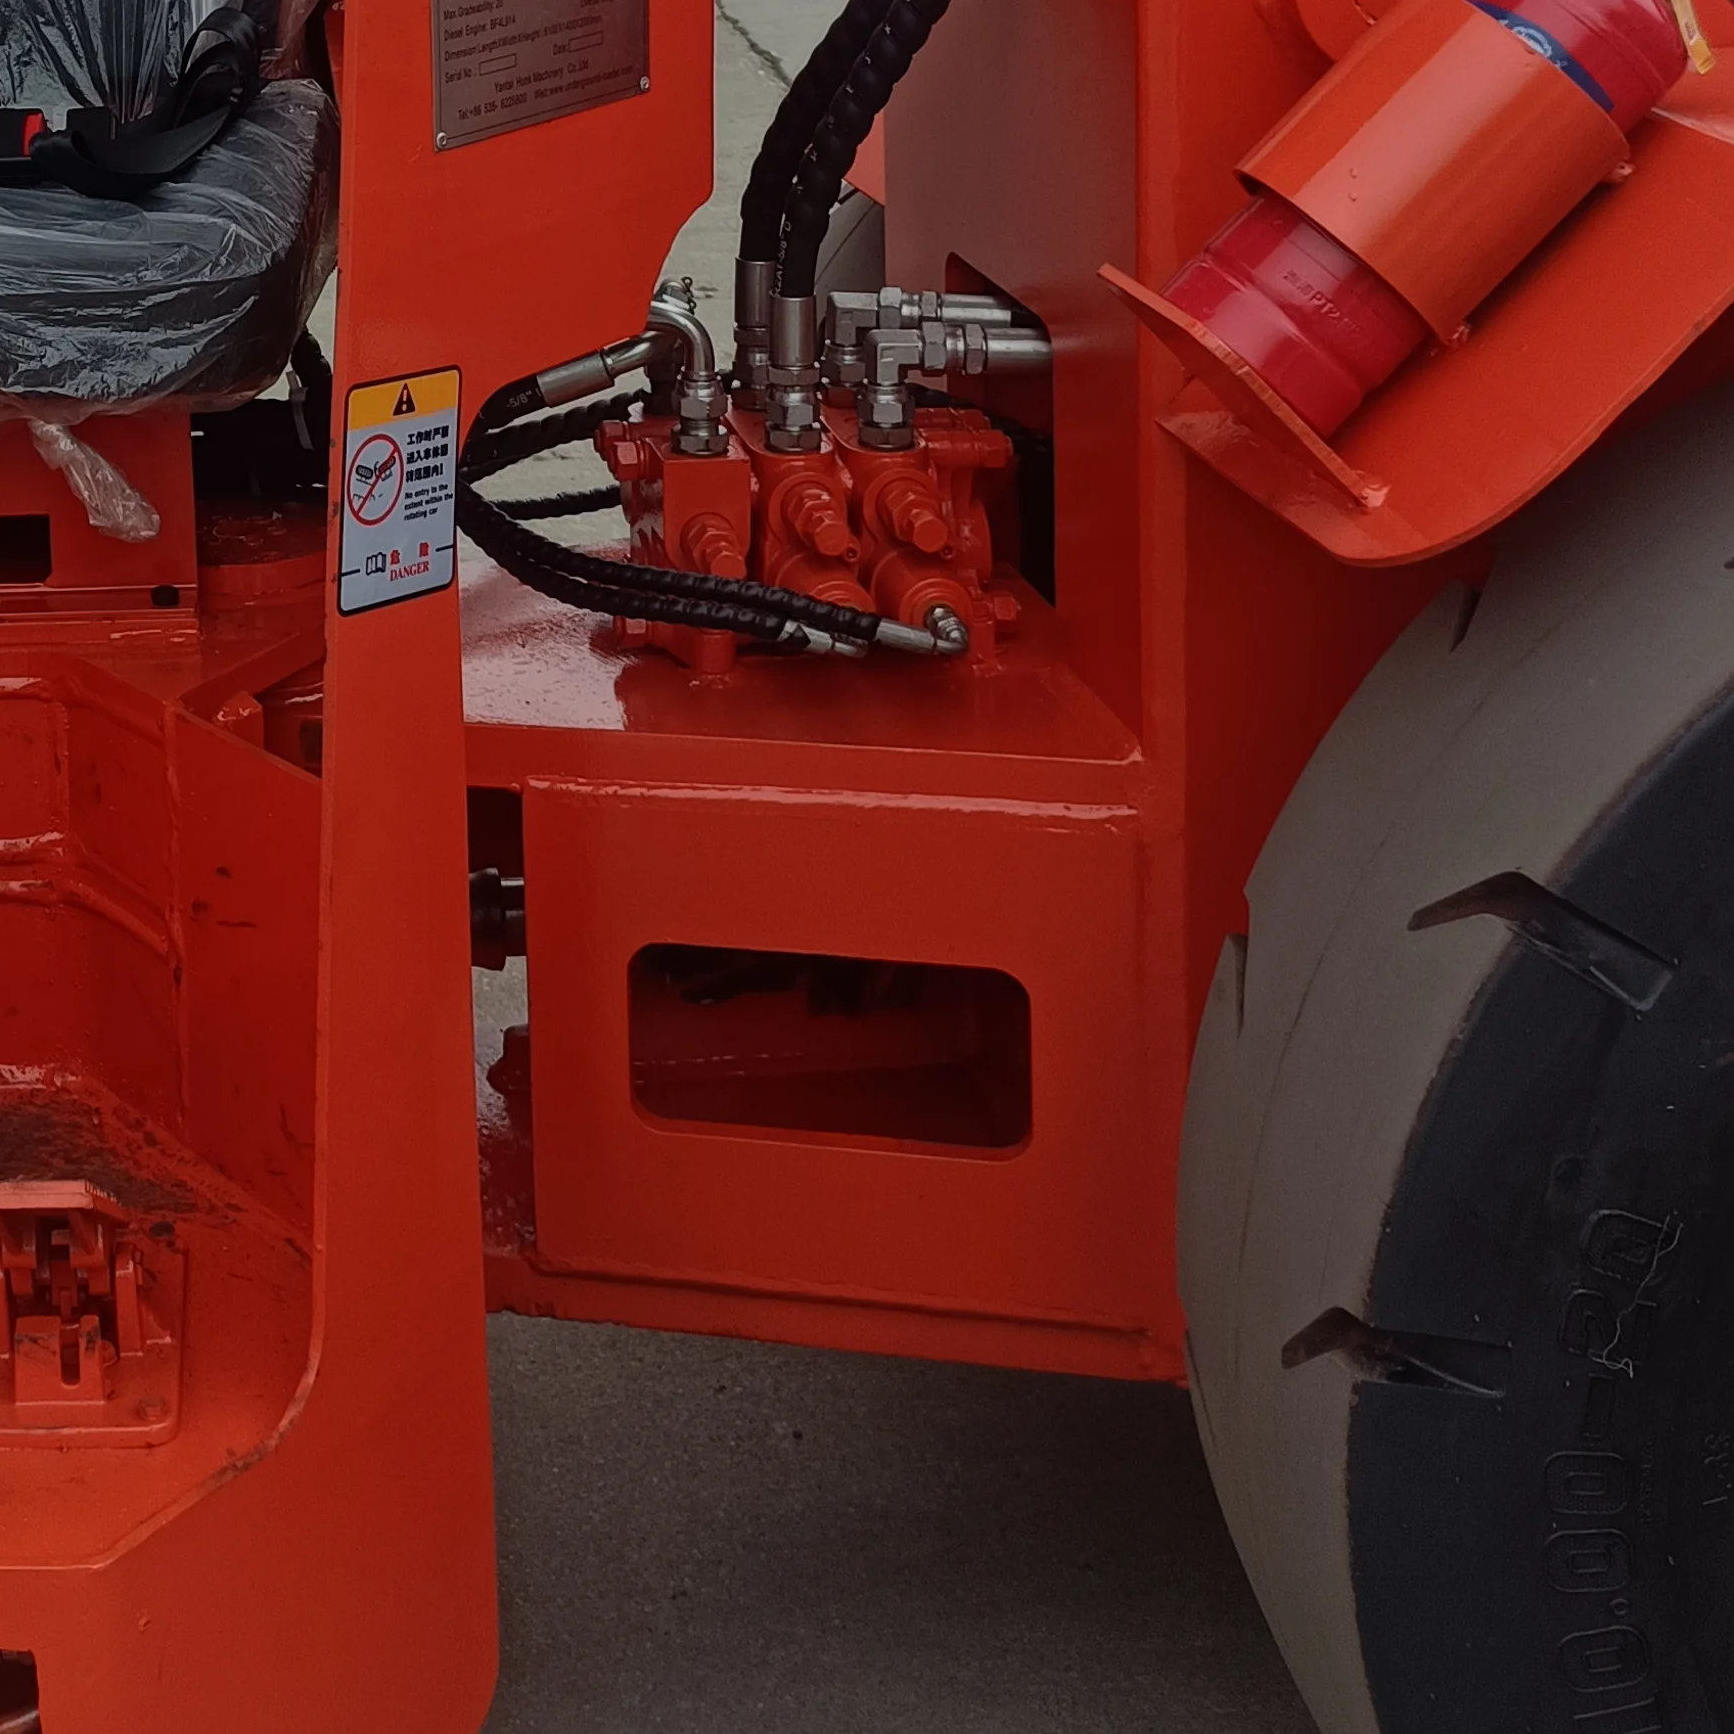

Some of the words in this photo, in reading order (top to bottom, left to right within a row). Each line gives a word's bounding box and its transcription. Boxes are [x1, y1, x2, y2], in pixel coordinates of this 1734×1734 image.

[414, 489, 429, 497] entry
[405, 500, 423, 510] extent
[425, 496, 442, 505] within
[404, 510, 427, 521] rotating
[429, 507, 438, 515] car
[390, 561, 429, 582] DANGER
